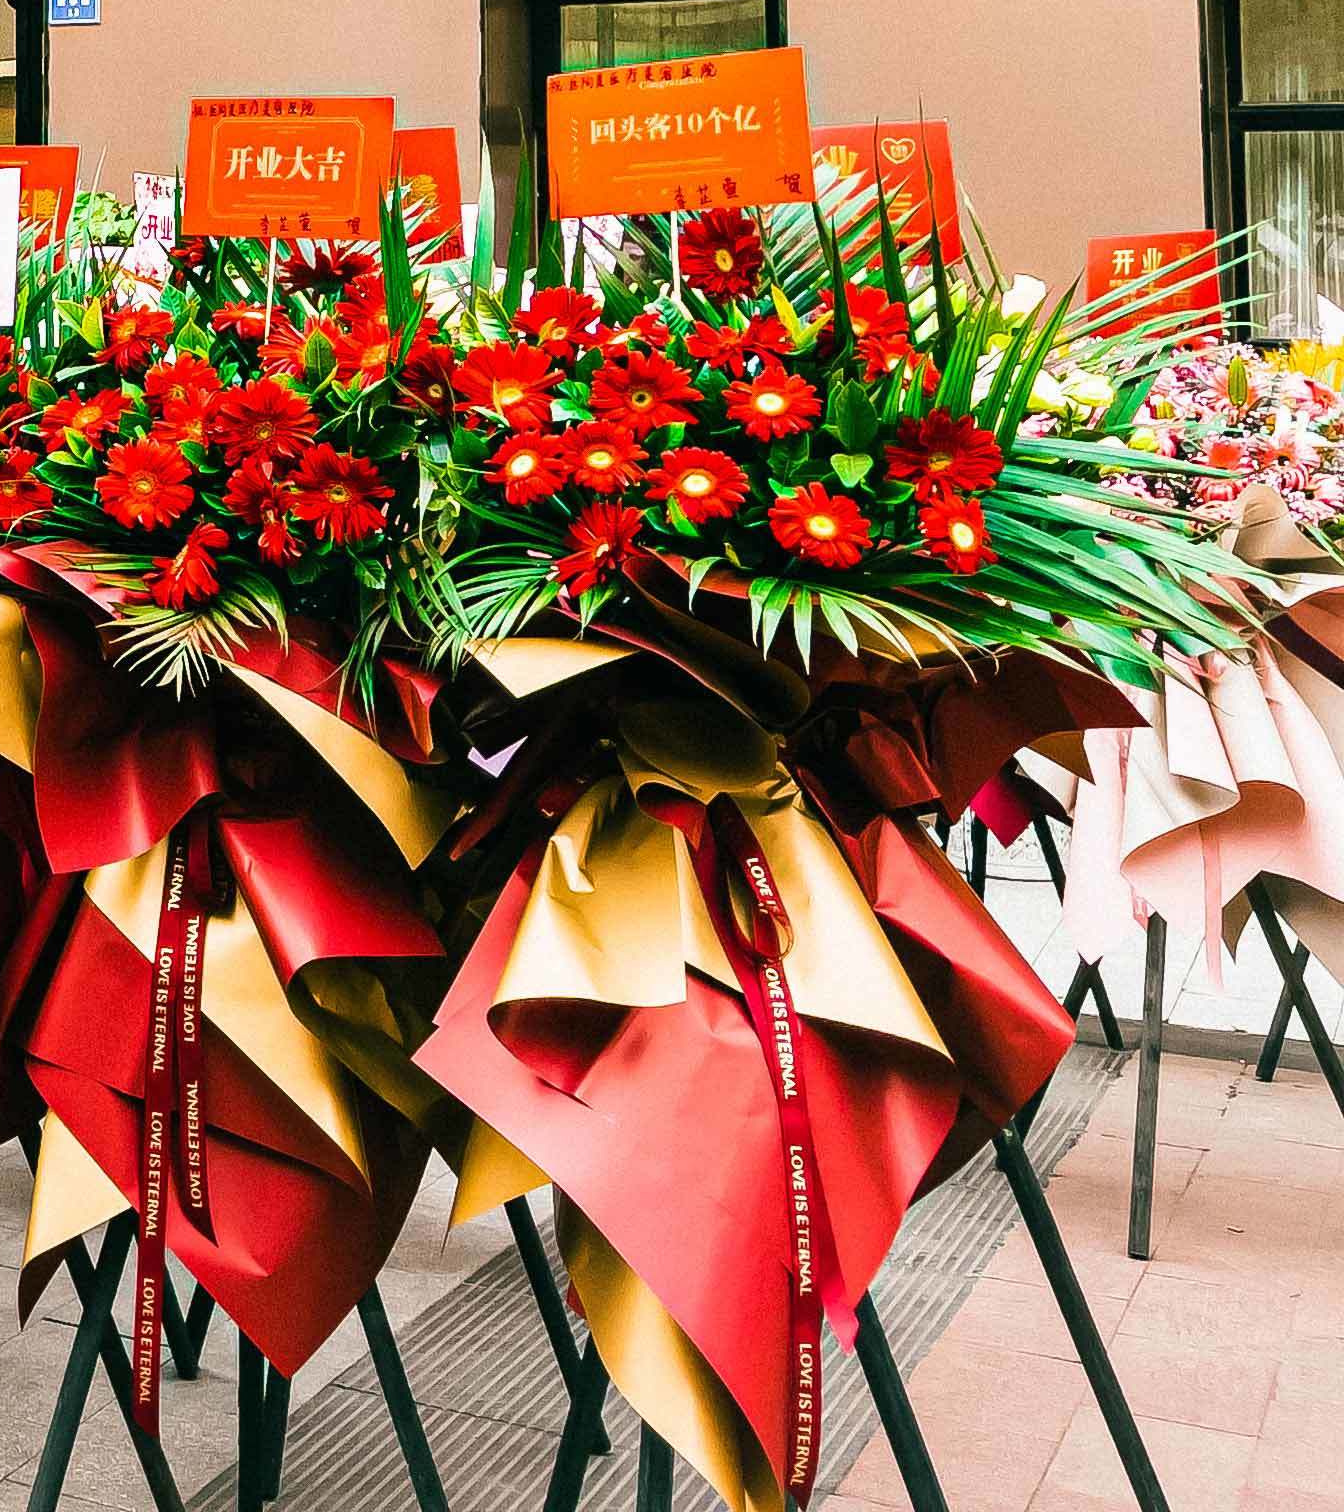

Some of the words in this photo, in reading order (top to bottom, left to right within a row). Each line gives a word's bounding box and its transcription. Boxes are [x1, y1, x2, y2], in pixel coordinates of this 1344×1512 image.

[590, 104, 761, 145] 回头客10个亿
[223, 145, 346, 182] 开业大吉
[1112, 248, 1163, 276] 开业
[166, 845, 186, 913] ETERNAL
[746, 856, 771, 898] LOVE
[159, 947, 174, 985] LOVE
[183, 915, 200, 980] ETERNAL
[156, 988, 169, 1004] IS
[183, 984, 195, 1000] IS
[763, 962, 785, 1000] OVE
[183, 1002, 195, 1043] LOVE
[772, 1001, 787, 1018] IS
[152, 1005, 168, 1073] ETERNAL
[773, 1020, 798, 1100] ETERNAL
[149, 1111, 163, 1150] LOVE
[187, 1080, 201, 1148] ETERNAL
[148, 1152, 162, 1168] IS
[188, 1150, 201, 1166] IS
[789, 1144, 807, 1191] LOVE
[145, 1170, 161, 1239] ETERNAL
[189, 1169, 202, 1208] LOVE
[793, 1194, 808, 1213] IS
[795, 1215, 813, 1297] ETERNAL
[143, 1277, 155, 1317] LOVE
[141, 1320, 153, 1335] IS
[139, 1337, 153, 1404] ETERNAL
[798, 1342, 813, 1387] LOVE
[797, 1389, 813, 1410] IS
[789, 1412, 813, 1486] ETERNAL
